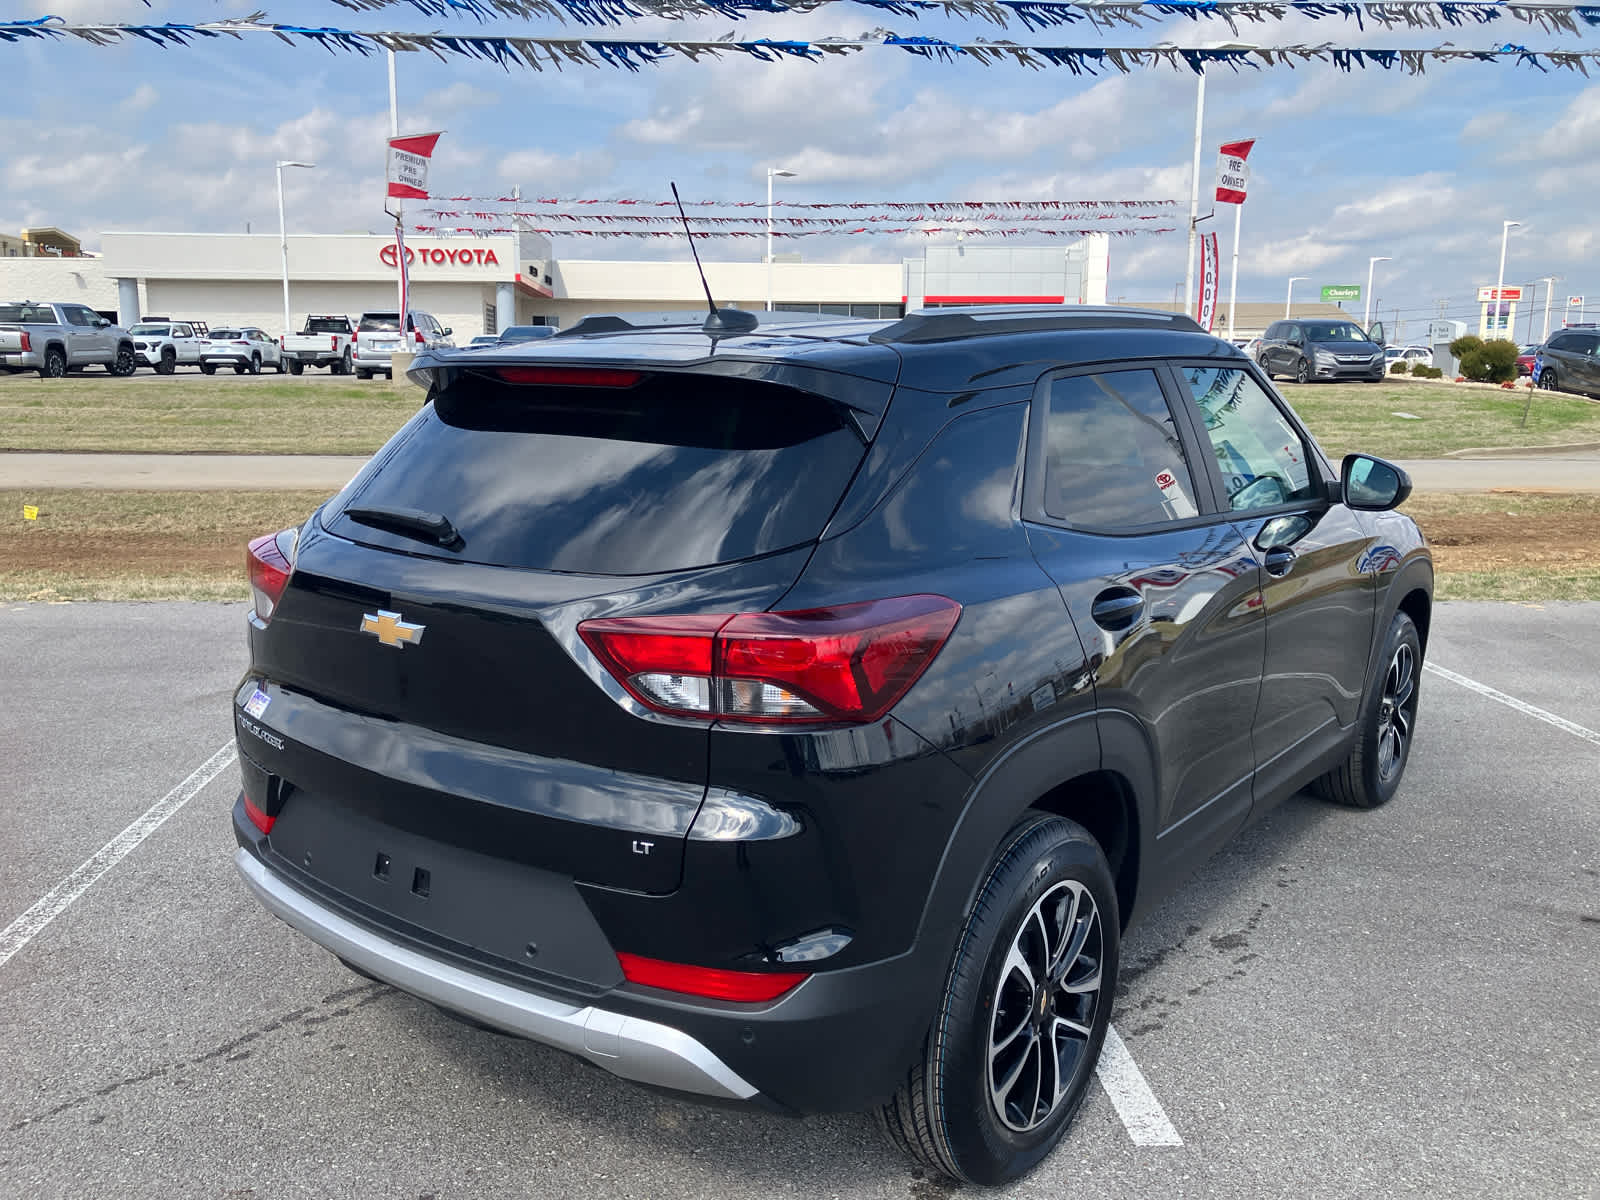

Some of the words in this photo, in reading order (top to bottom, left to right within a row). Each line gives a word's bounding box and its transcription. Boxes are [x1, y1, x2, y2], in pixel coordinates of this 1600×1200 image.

[395, 151, 427, 166] PREMIUM
[1228, 159, 1242, 172] PRE
[403, 165, 417, 175] PRE
[398, 174, 423, 187] OWNED
[1221, 174, 1245, 188] OWNED
[418, 248, 499, 265] TOYOTA
[632, 840, 655, 855] LT
